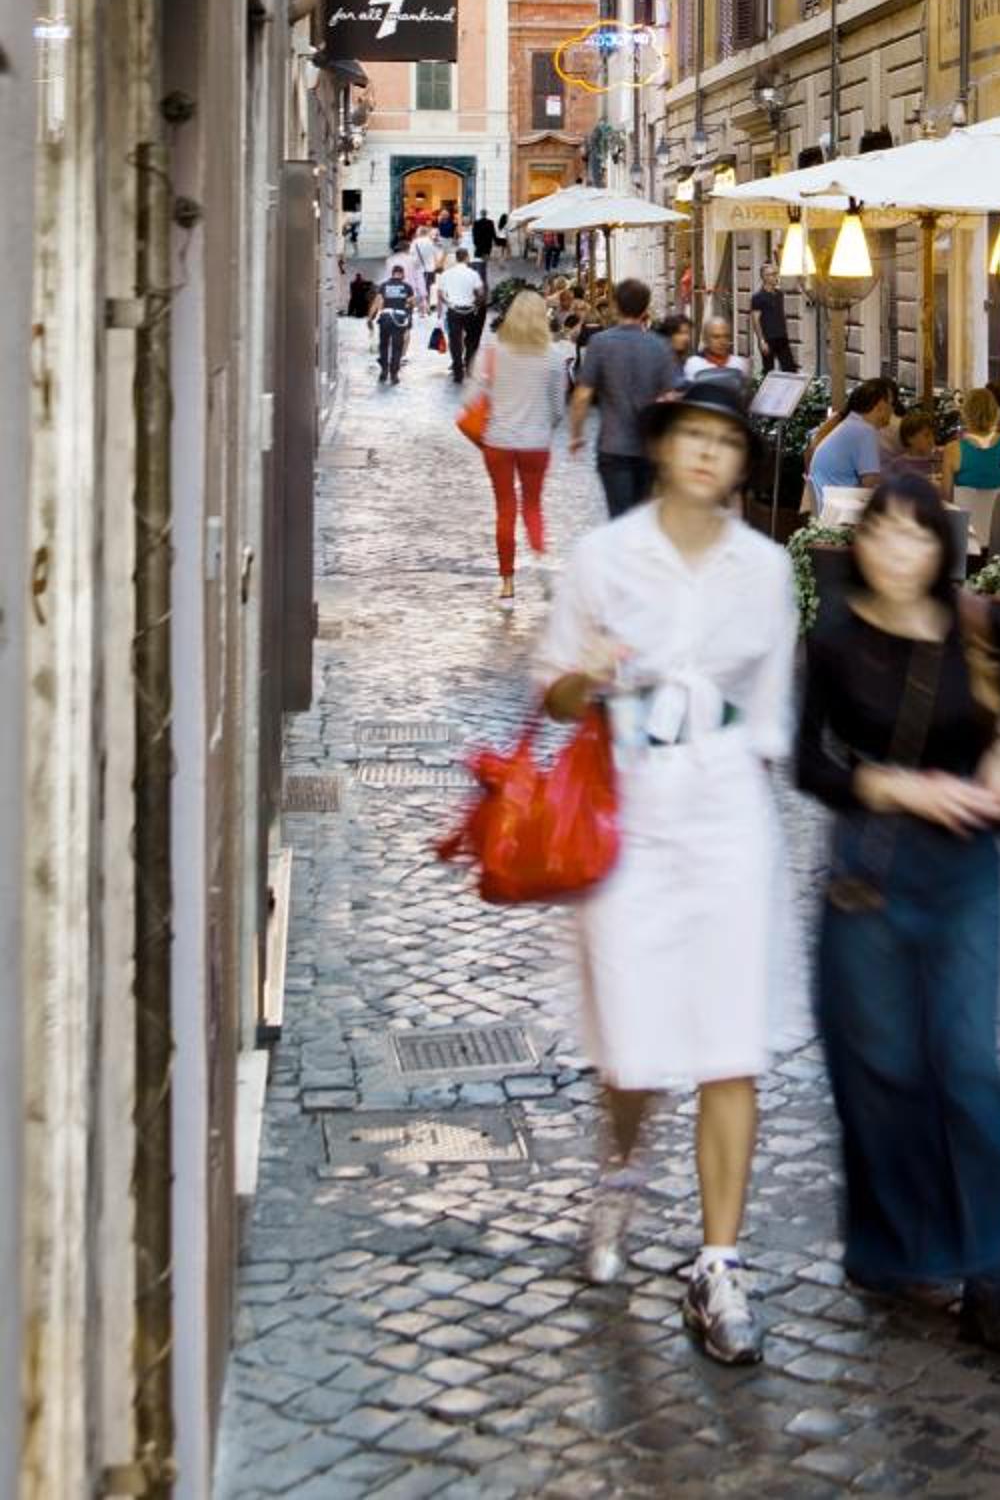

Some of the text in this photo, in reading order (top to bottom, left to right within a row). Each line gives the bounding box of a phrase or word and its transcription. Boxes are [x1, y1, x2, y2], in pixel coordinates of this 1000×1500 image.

[328, 7, 457, 27] for all mankind
